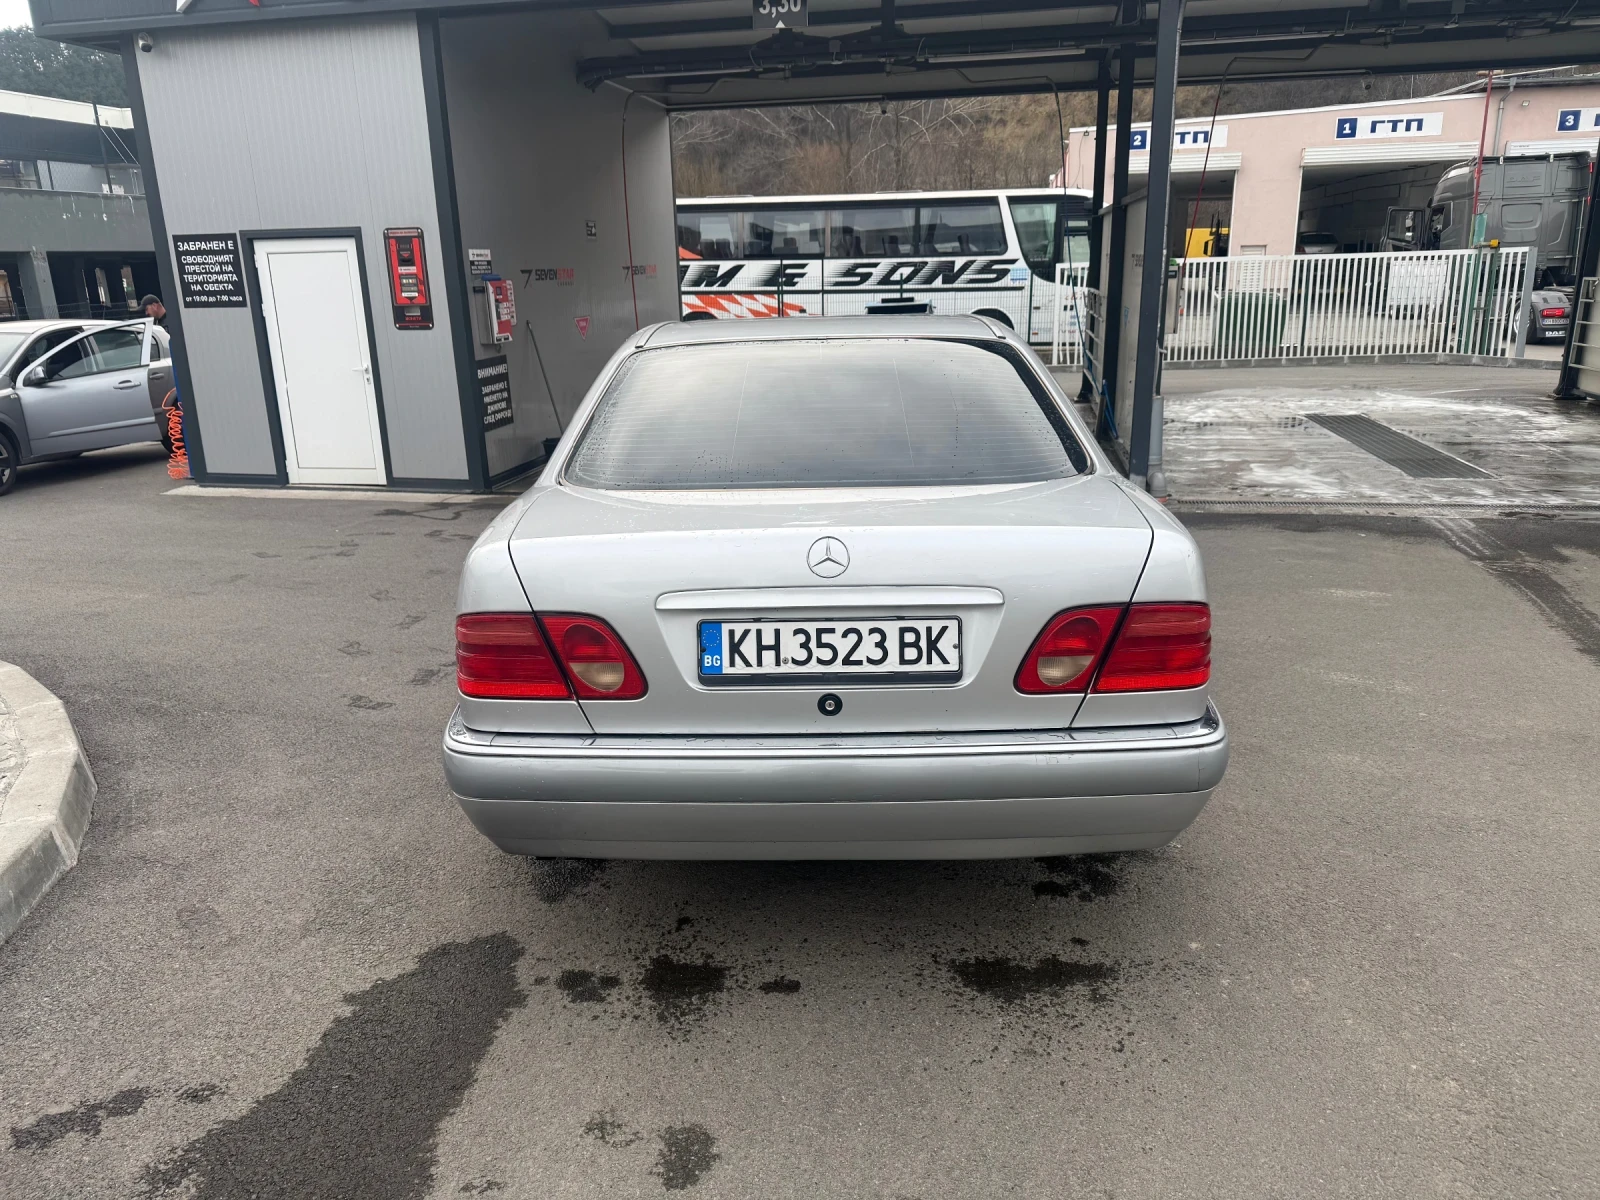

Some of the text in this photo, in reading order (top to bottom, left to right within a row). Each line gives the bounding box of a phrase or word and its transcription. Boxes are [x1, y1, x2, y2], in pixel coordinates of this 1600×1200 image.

[1343, 118, 1423, 134] 1 ГТП
[1565, 116, 1574, 126] 3
[1133, 131, 1209, 146] 2 ТП
[177, 240, 234, 251] ЗАБРАНЕН Е
[181, 254, 234, 264] СВОБОДНИЯТ
[185, 263, 234, 273] ПРЕСТОЙ НА
[824, 258, 1019, 287] SONS
[183, 273, 238, 282] ТЕРИТОРИЯТА
[203, 283, 234, 291] ОБЕКТА
[728, 626, 951, 667] KH 3523 BK
[704, 656, 720, 666] BG
